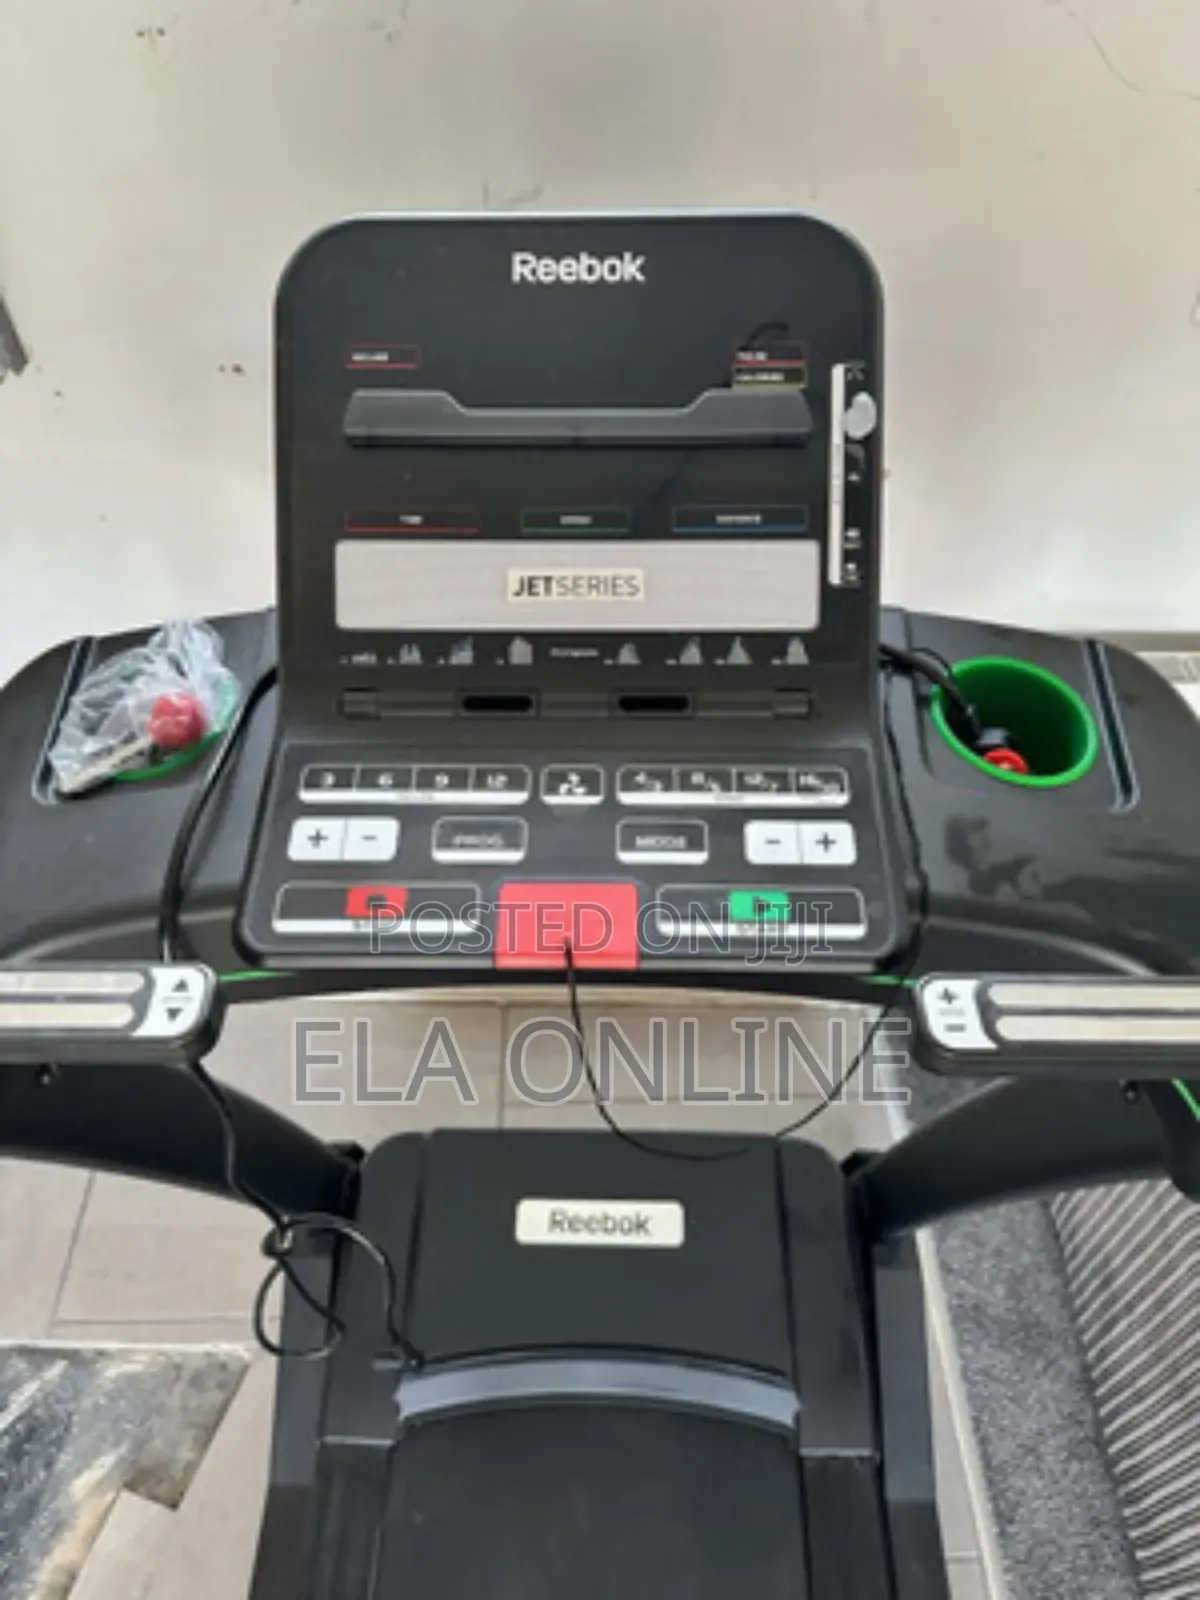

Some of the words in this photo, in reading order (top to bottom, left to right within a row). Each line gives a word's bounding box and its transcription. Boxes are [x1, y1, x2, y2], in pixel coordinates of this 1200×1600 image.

[511, 250, 646, 285] Reebok
[512, 575, 641, 598] JETSERIES
[548, 1208, 653, 1237] Reebok
